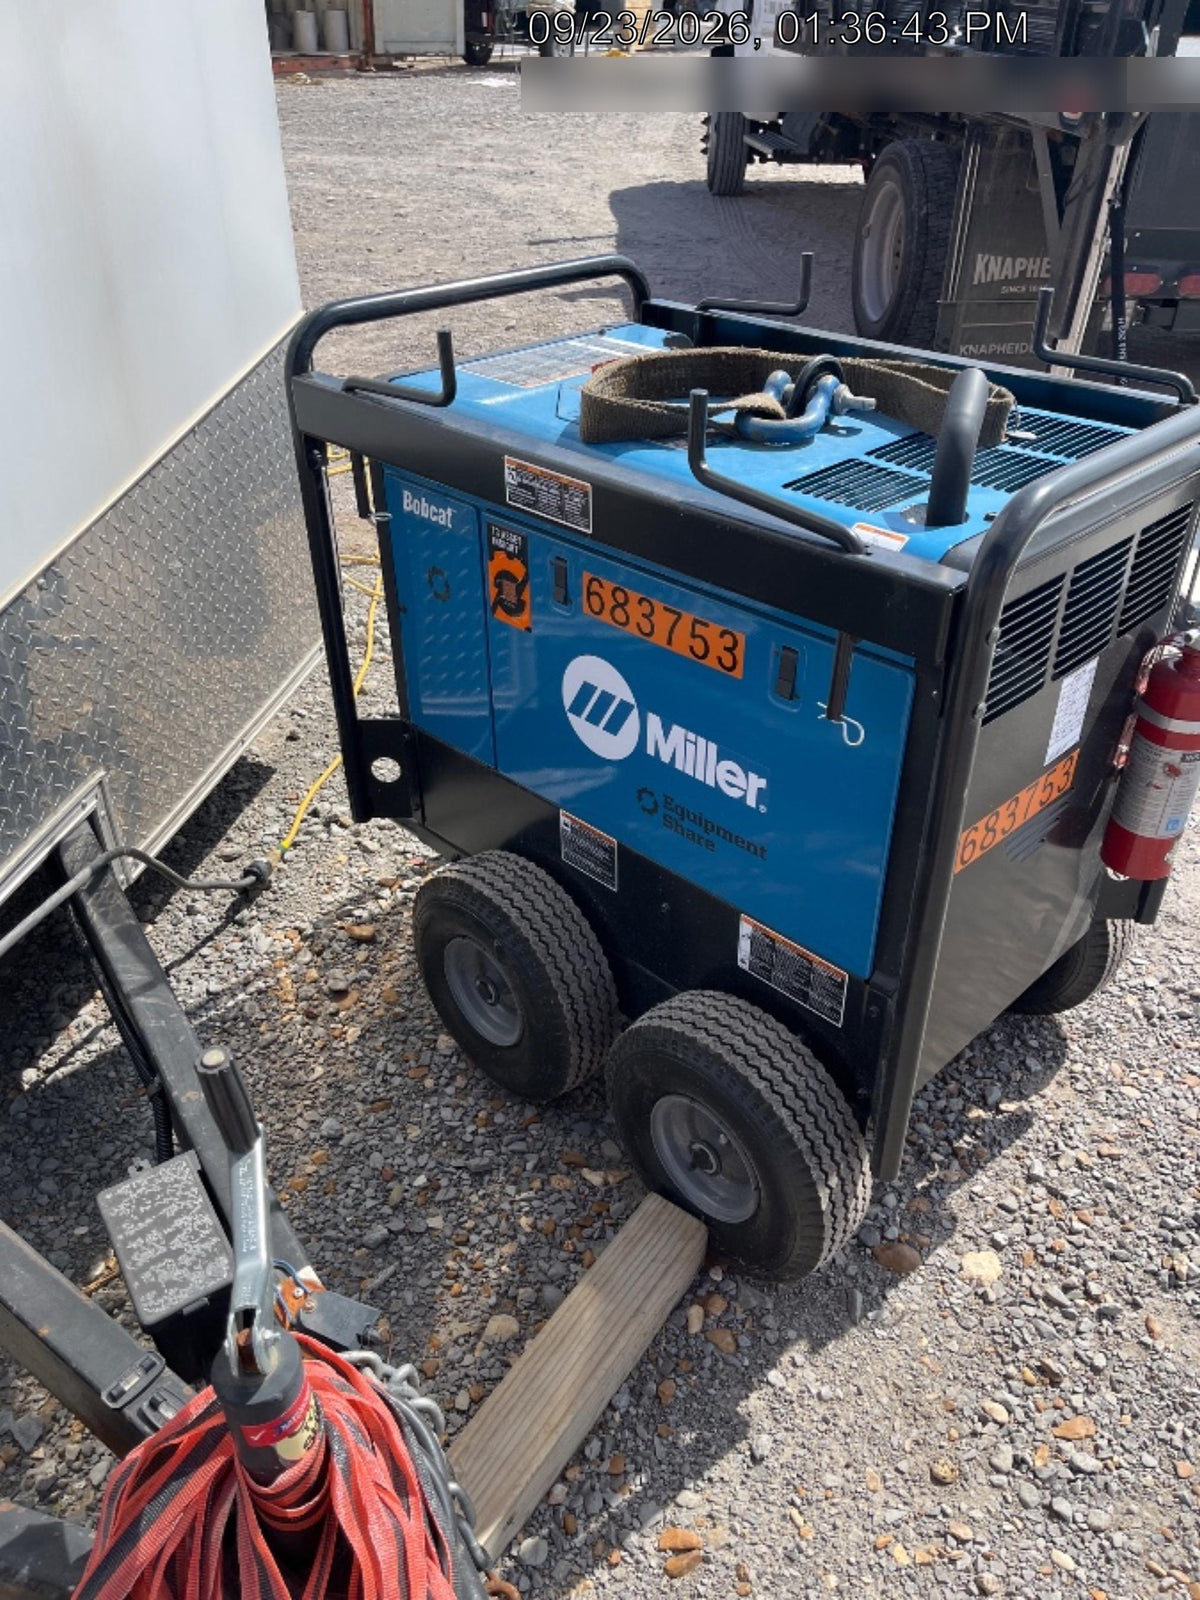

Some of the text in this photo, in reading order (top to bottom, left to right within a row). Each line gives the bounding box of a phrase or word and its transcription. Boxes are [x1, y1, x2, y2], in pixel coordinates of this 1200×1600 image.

[972, 253, 1052, 285] KNAPHE
[402, 489, 453, 529] Bobcat
[585, 576, 739, 673] 683753
[646, 711, 767, 809] Miller
[662, 792, 768, 861] Equipment
[662, 813, 716, 853] Share
[960, 754, 1074, 867] 683753
